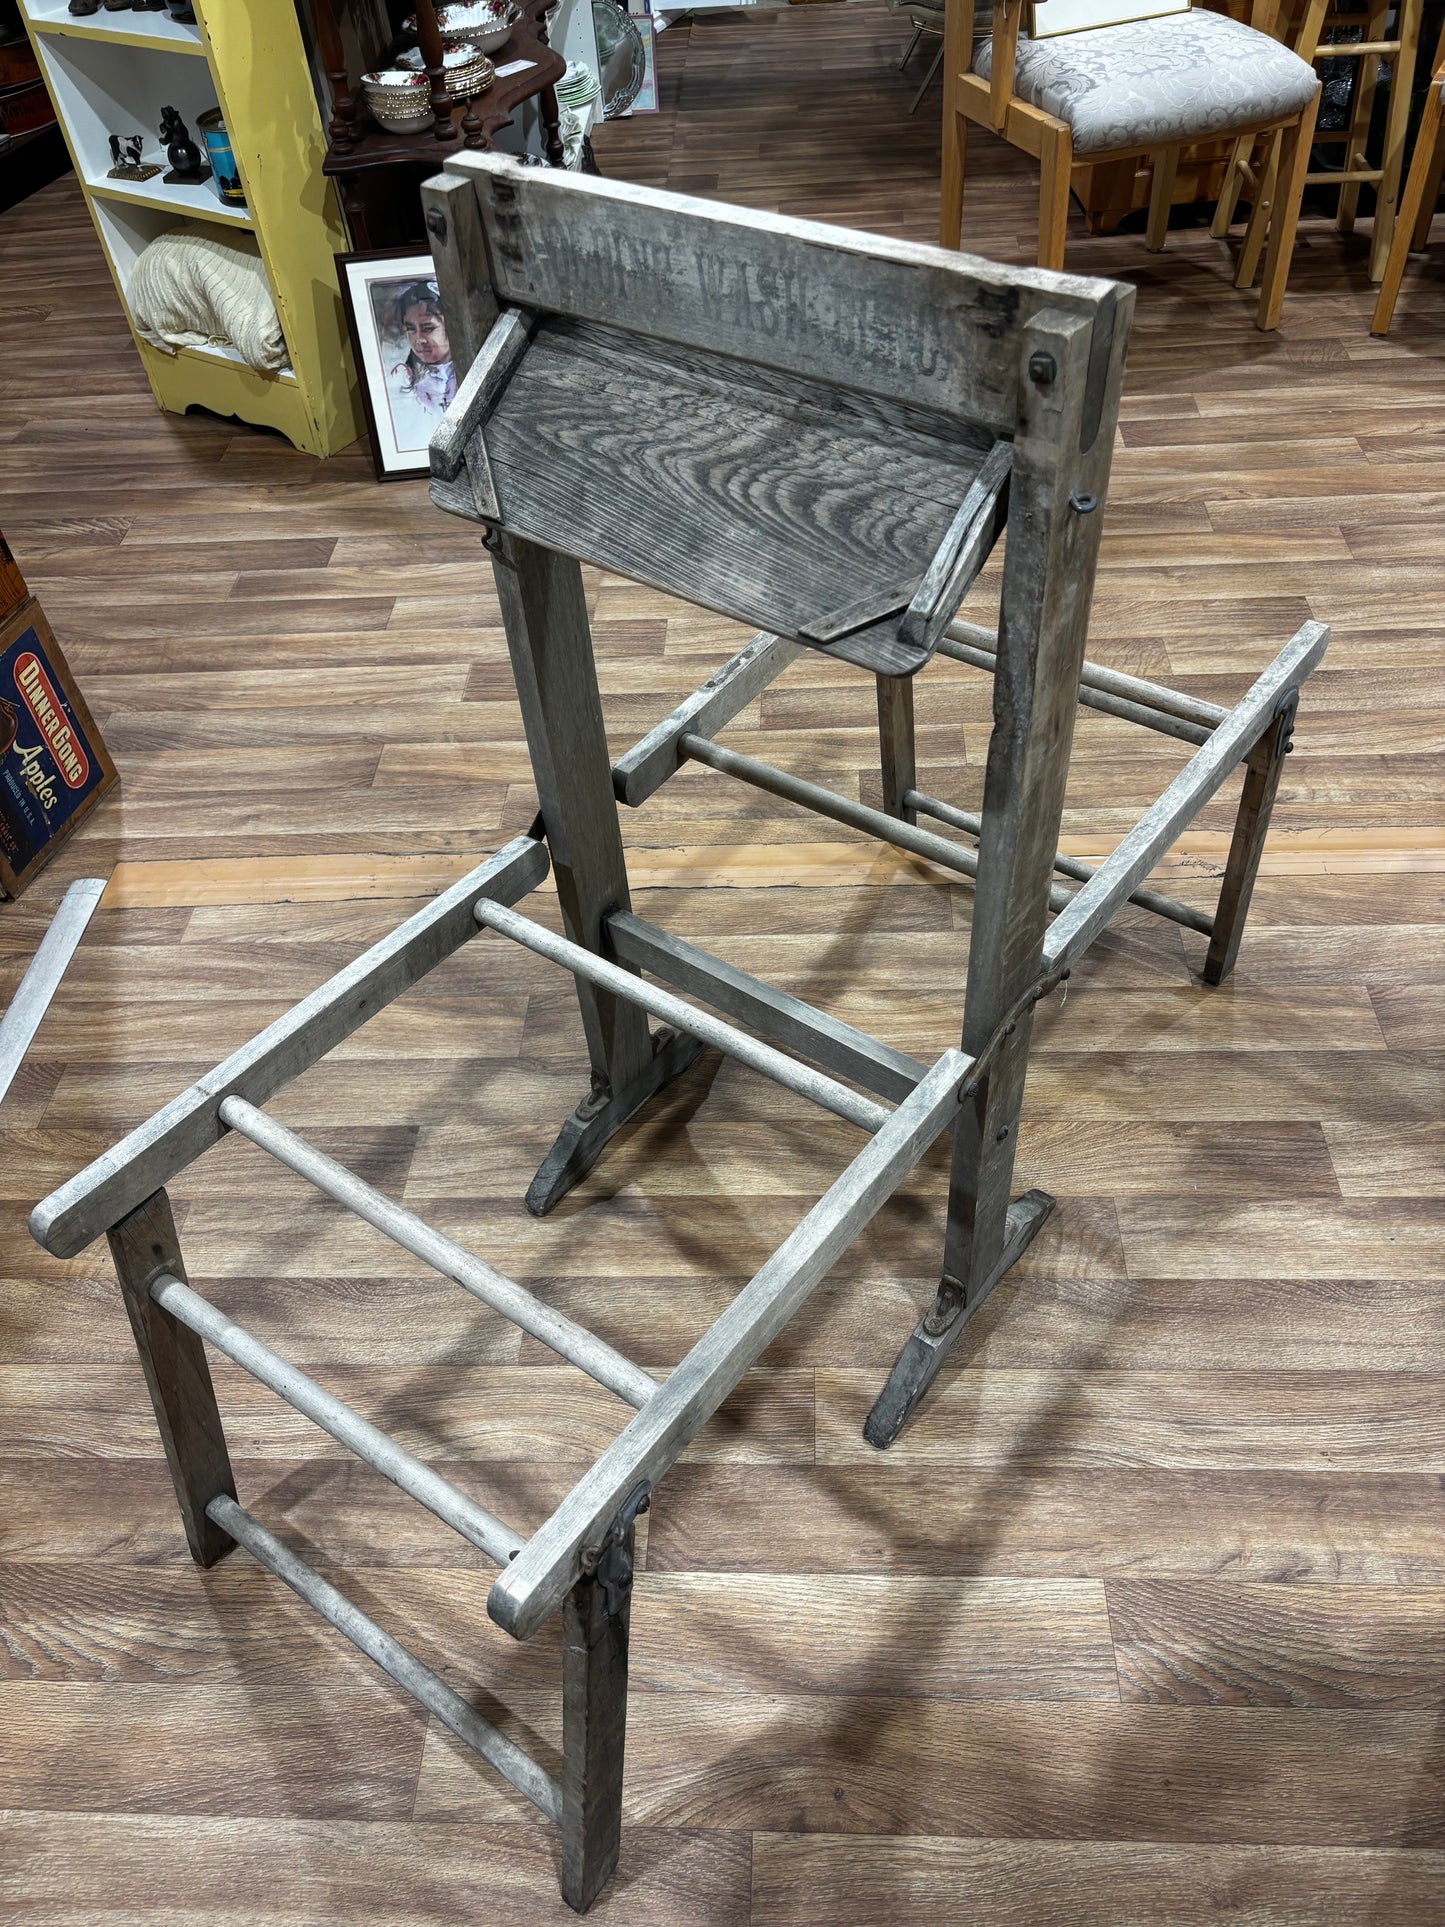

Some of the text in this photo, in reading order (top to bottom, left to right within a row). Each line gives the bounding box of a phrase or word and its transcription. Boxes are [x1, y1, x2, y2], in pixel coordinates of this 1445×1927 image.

[694, 250, 809, 345] WASH
[829, 282, 964, 384] BEC
[18, 659, 83, 783] DINNER GONG
[3, 769, 22, 800] PRODUCED
[13, 739, 58, 811] Apples
